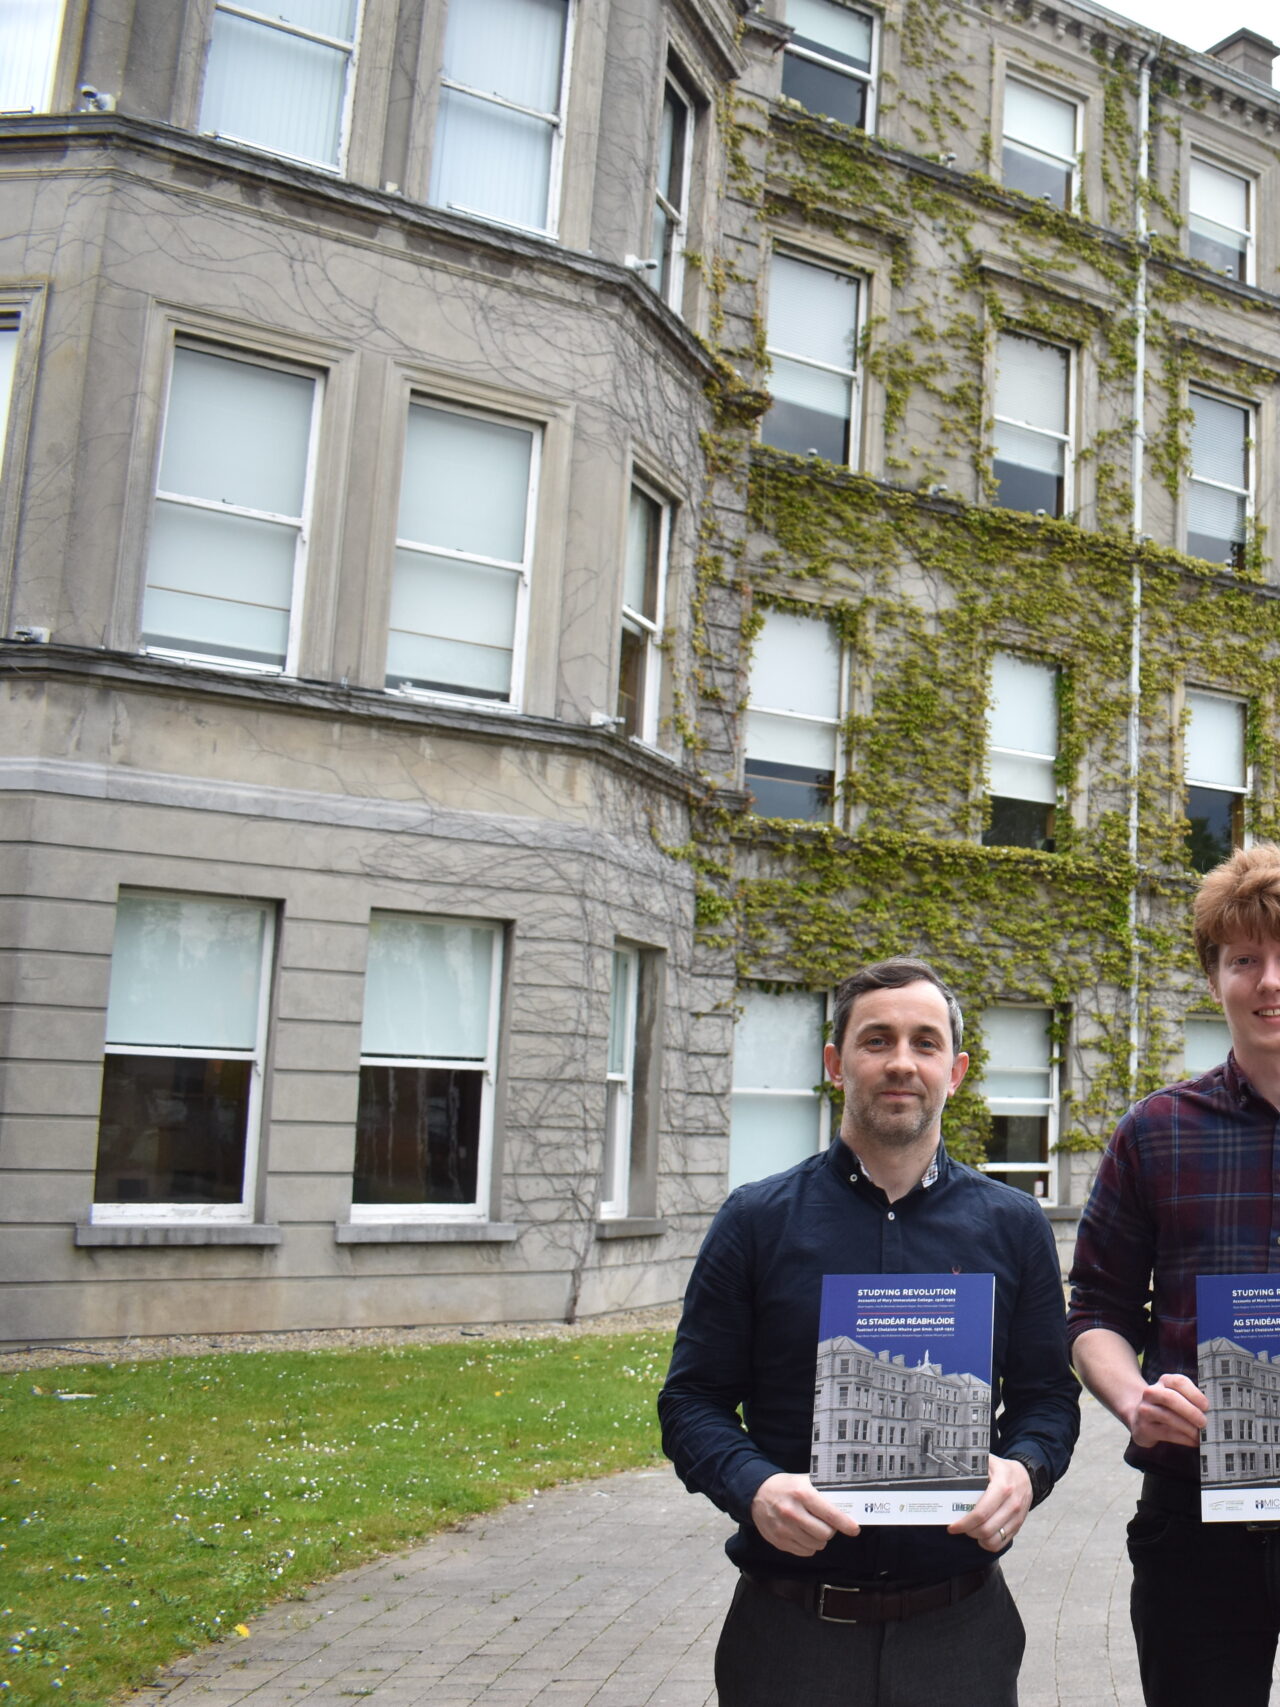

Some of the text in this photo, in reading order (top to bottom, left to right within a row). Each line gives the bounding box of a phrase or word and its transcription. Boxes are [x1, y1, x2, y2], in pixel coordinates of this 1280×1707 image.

[902, 1288, 956, 1296] REVOLUTION
[1232, 1288, 1274, 1297] STUDYING
[868, 1316, 905, 1325] STAIDÉAR
[907, 1316, 955, 1325] RÉABHLÓIDE
[1245, 1317, 1280, 1326] STAIDÉAR
[874, 1502, 891, 1510] MIC
[1264, 1498, 1280, 1507] MIC
